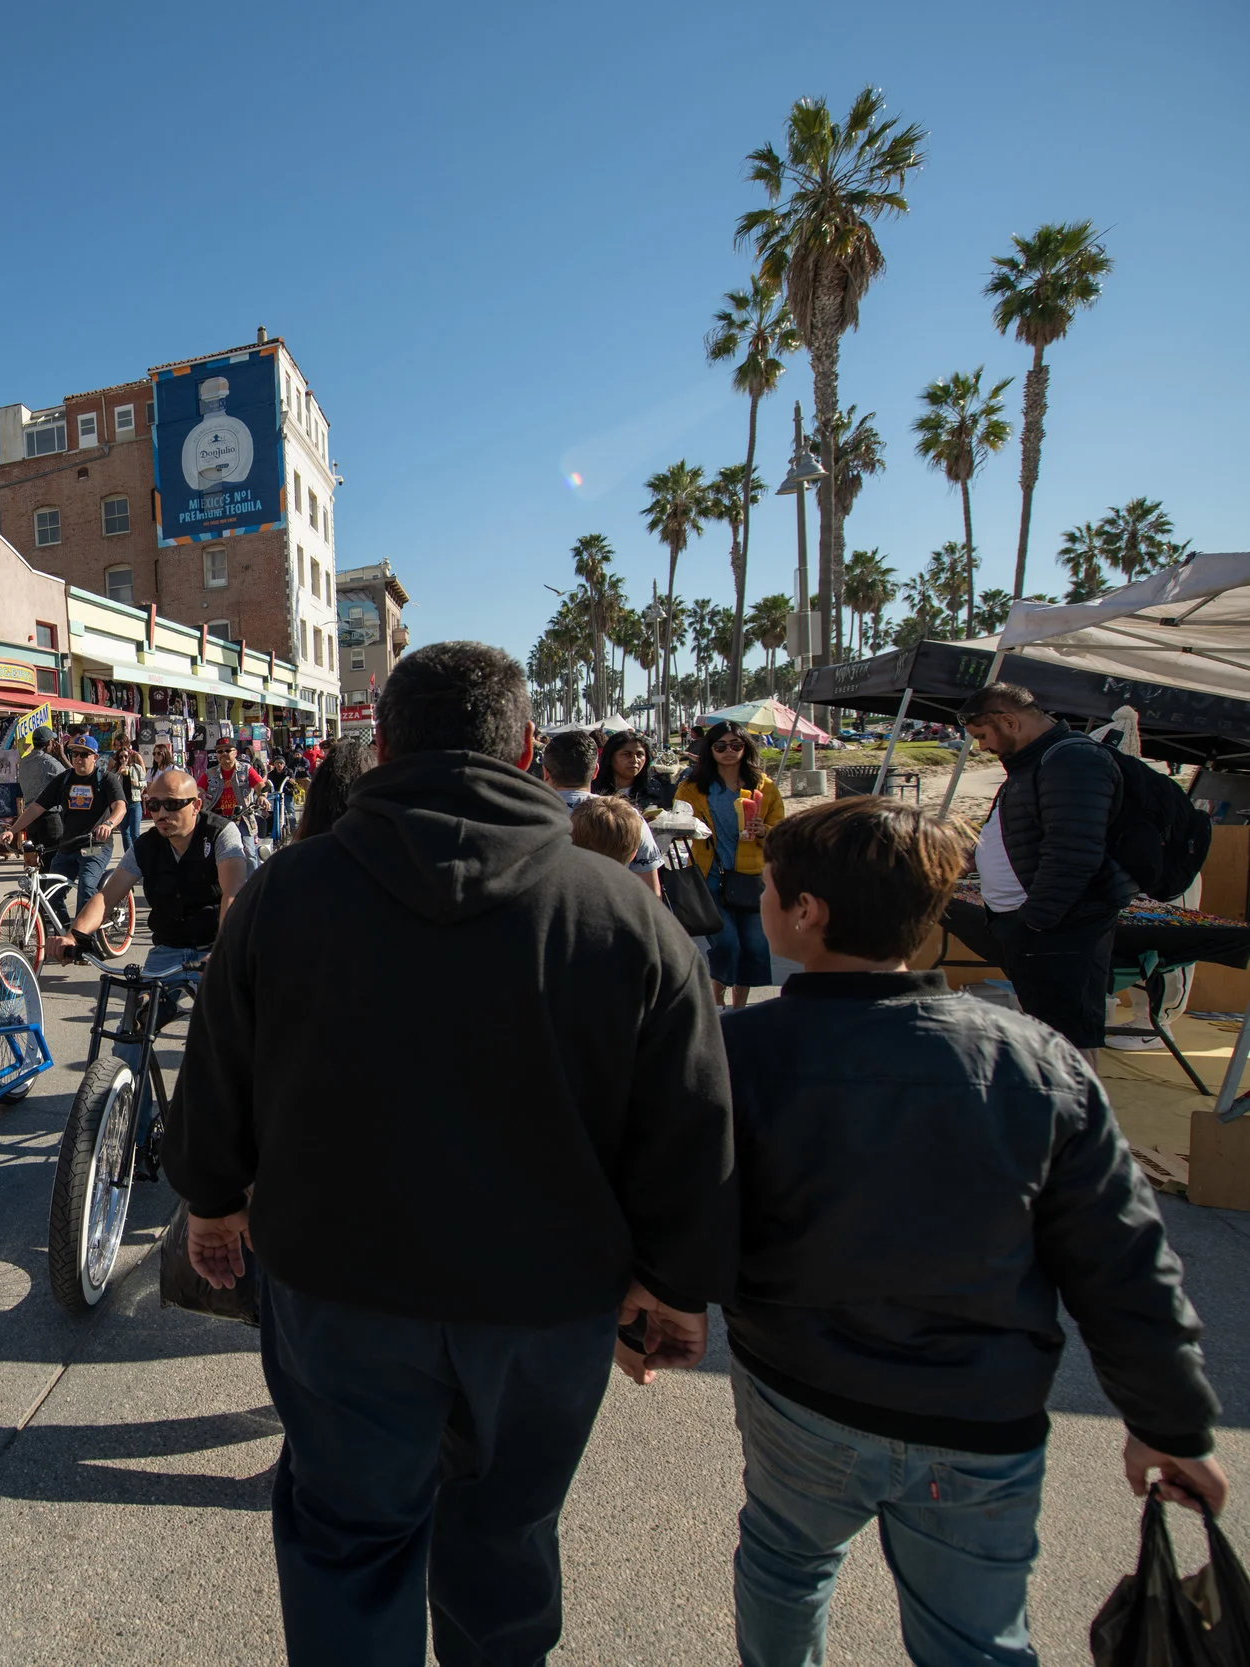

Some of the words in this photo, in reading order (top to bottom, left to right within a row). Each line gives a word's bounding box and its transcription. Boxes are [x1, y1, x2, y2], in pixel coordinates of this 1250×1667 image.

[225, 500, 262, 515] TEQUILA
[17, 720, 28, 740] ICE
[28, 704, 49, 732] CREAM
